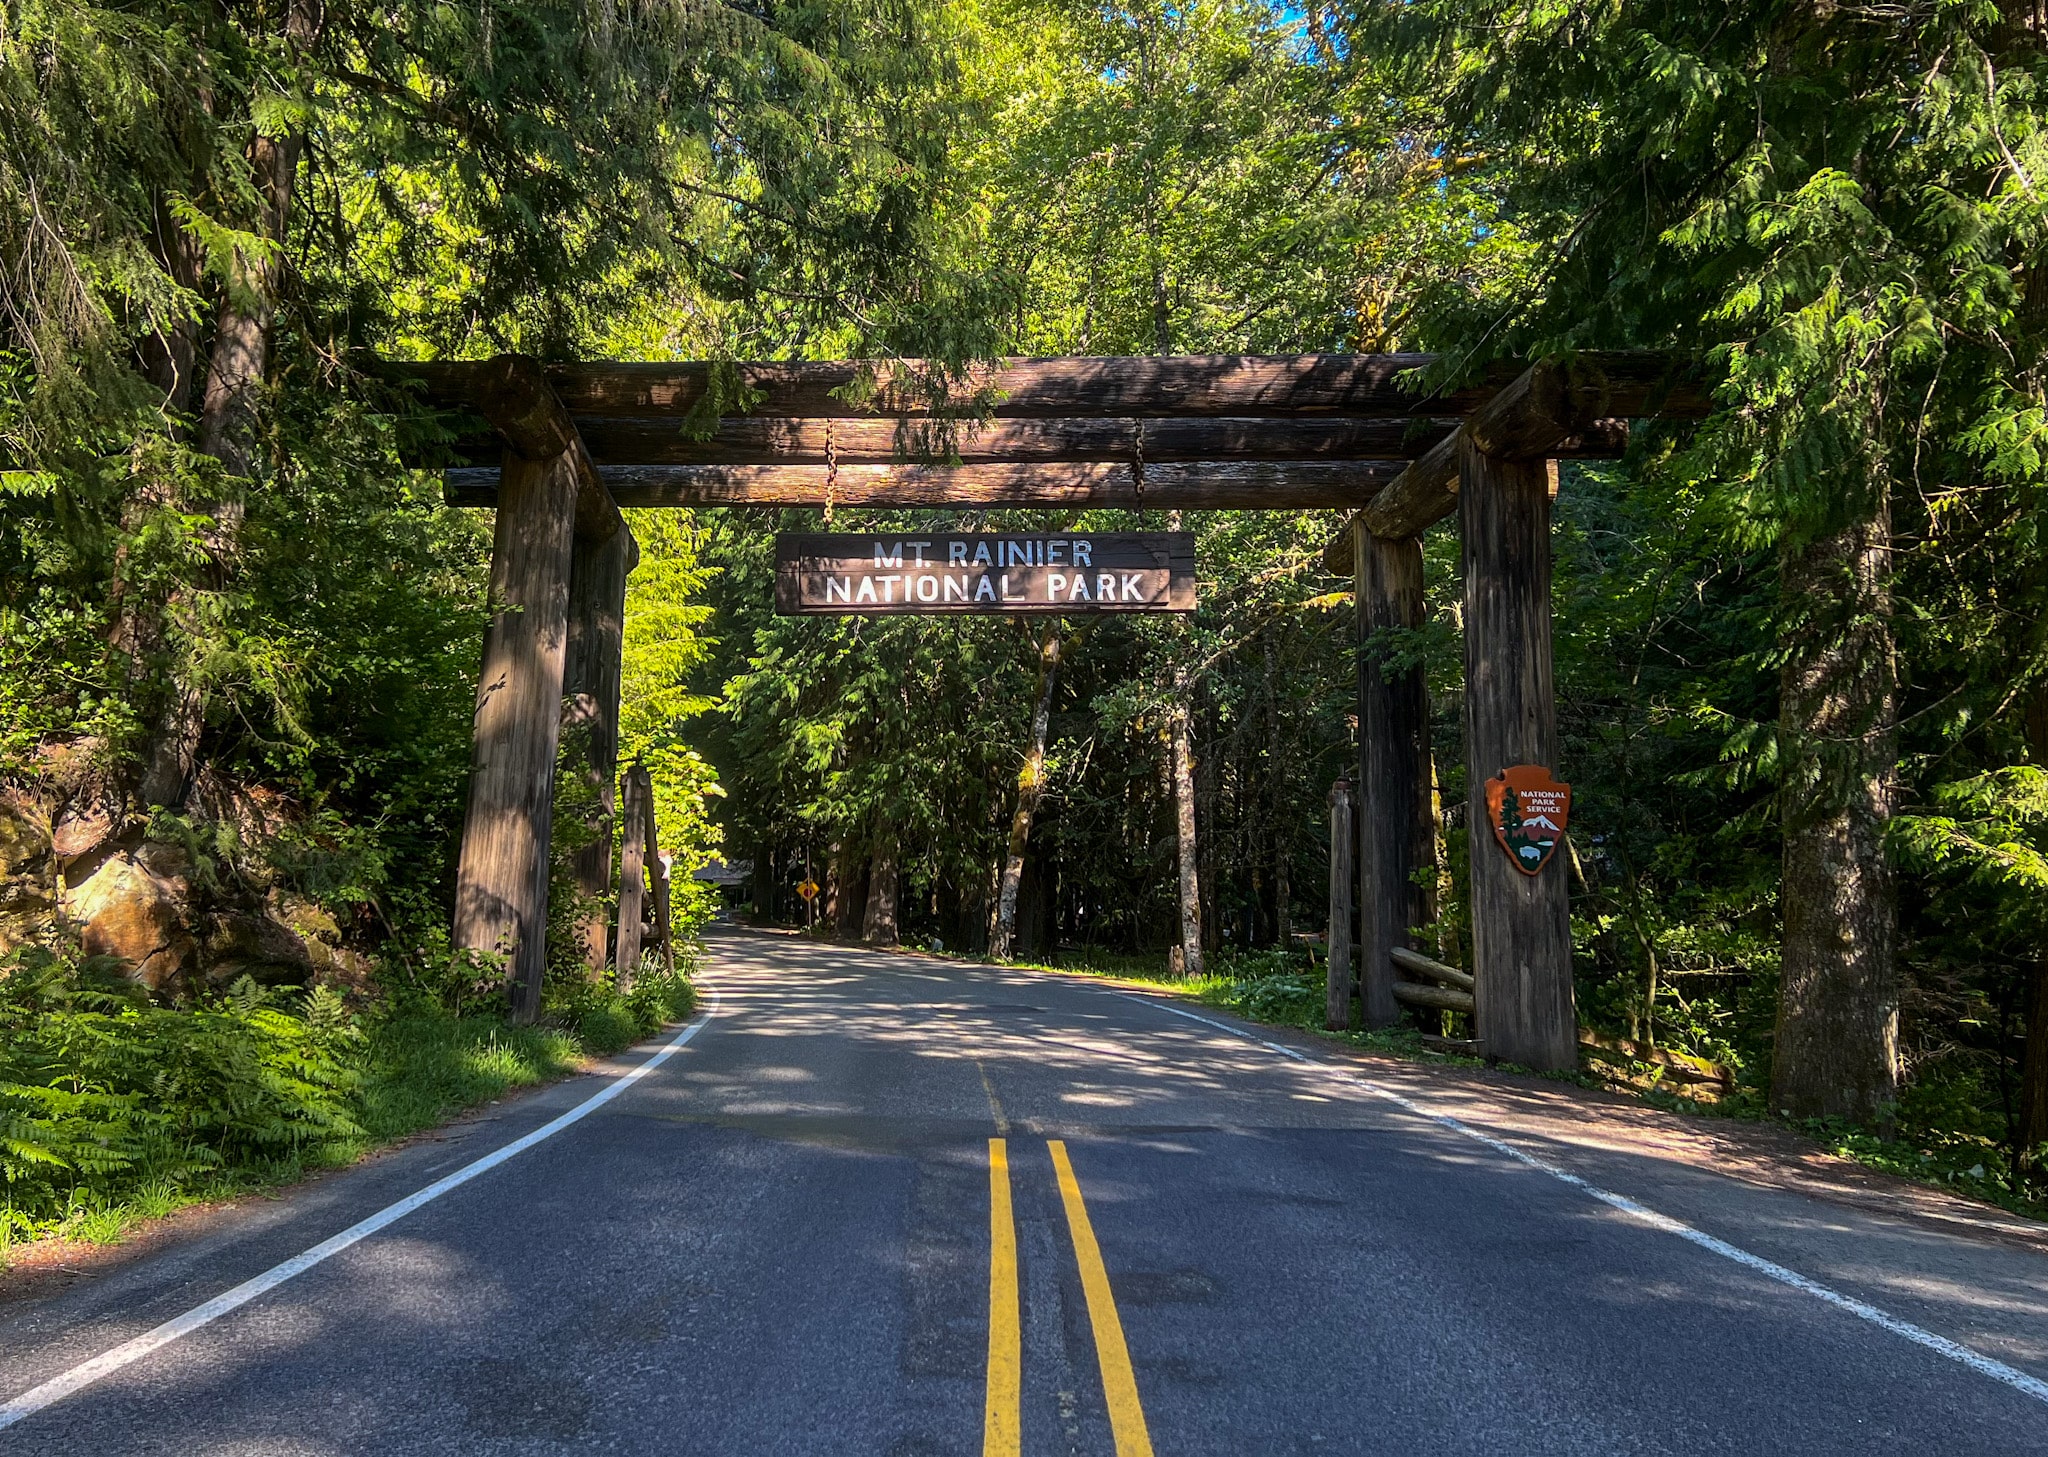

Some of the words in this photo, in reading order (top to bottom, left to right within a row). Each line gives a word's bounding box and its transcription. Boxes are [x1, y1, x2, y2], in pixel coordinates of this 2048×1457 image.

[949, 540, 1093, 568] RAINIER
[825, 573, 1025, 604] NATIONAL
[1047, 573, 1145, 602] PARK
